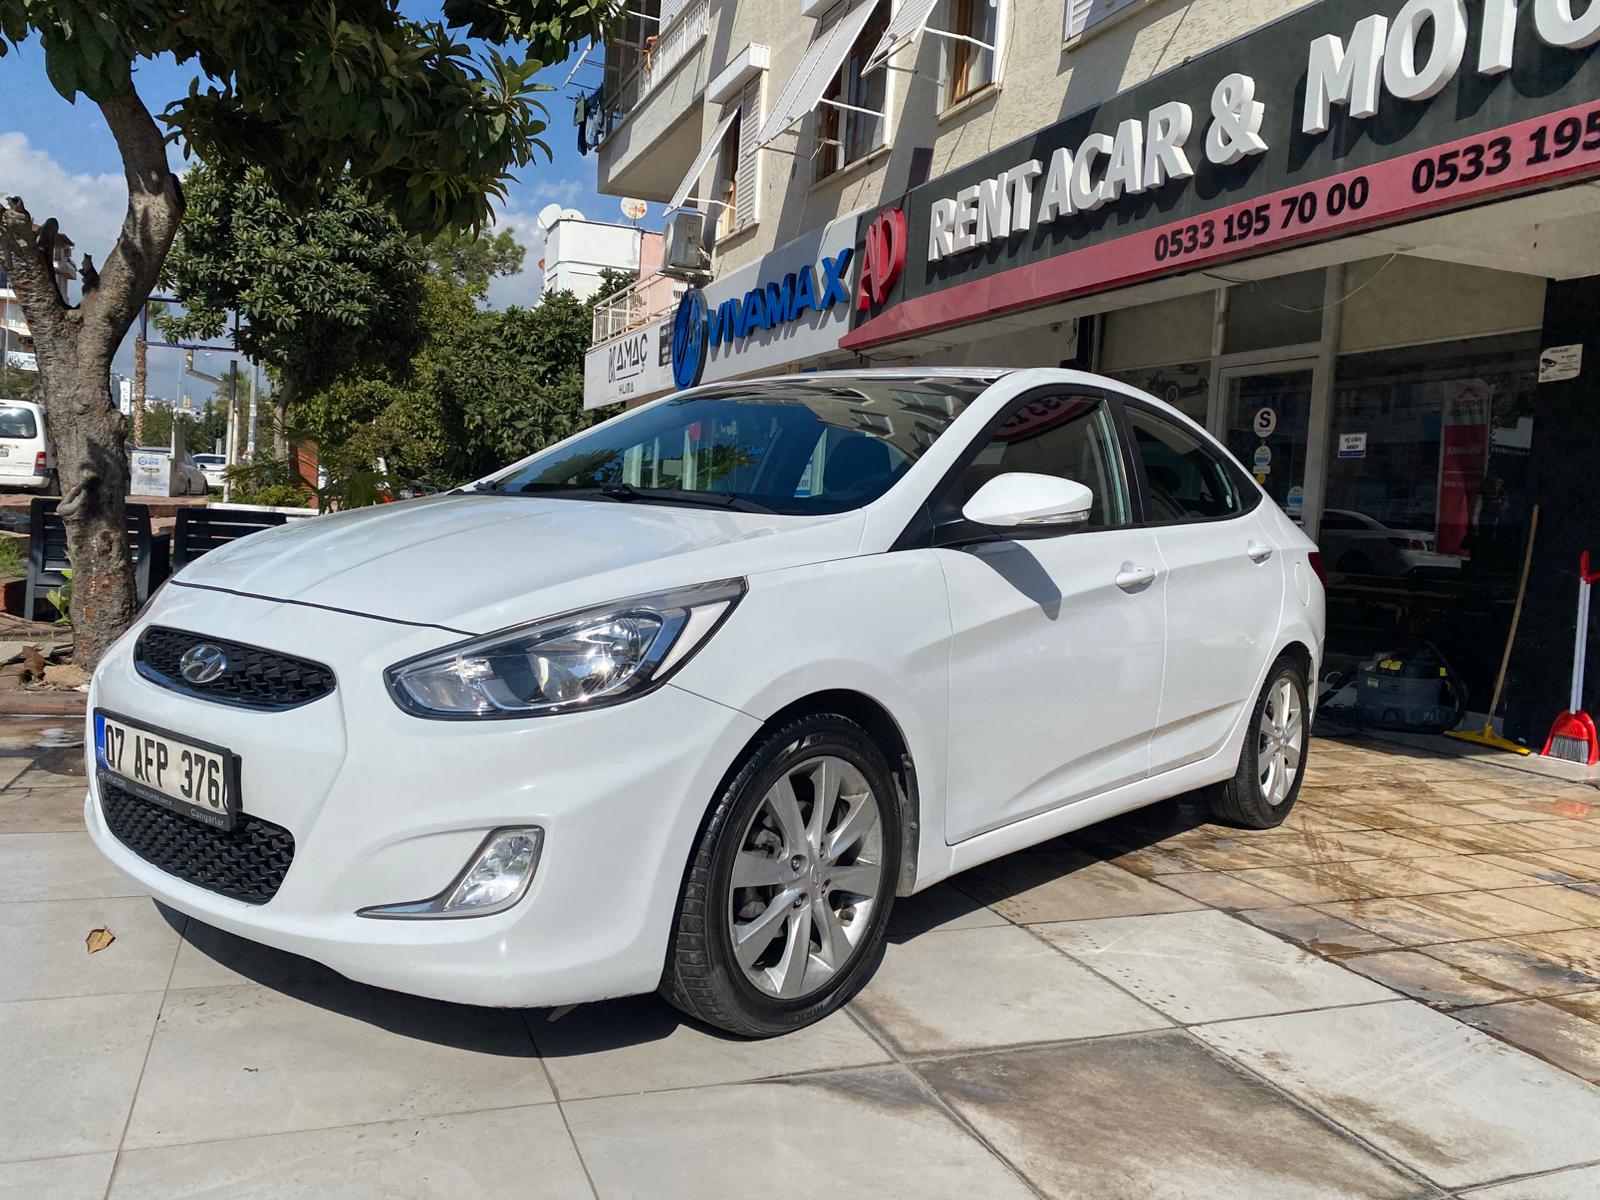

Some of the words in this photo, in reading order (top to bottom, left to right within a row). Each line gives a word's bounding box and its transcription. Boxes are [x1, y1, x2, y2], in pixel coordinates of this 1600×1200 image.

[1206, 72, 1268, 165] &
[1154, 220, 1215, 262] 0533
[1223, 203, 1270, 244] 195
[1280, 191, 1317, 229] 70
[1326, 176, 1369, 216] 00
[1412, 136, 1512, 193] 0533
[1526, 110, 1600, 166] 195
[706, 247, 855, 347] VIVAMAX
[1260, 411, 1271, 428] S
[106, 724, 124, 771] 07
[134, 735, 169, 788] AFP
[180, 750, 220, 808] 376
